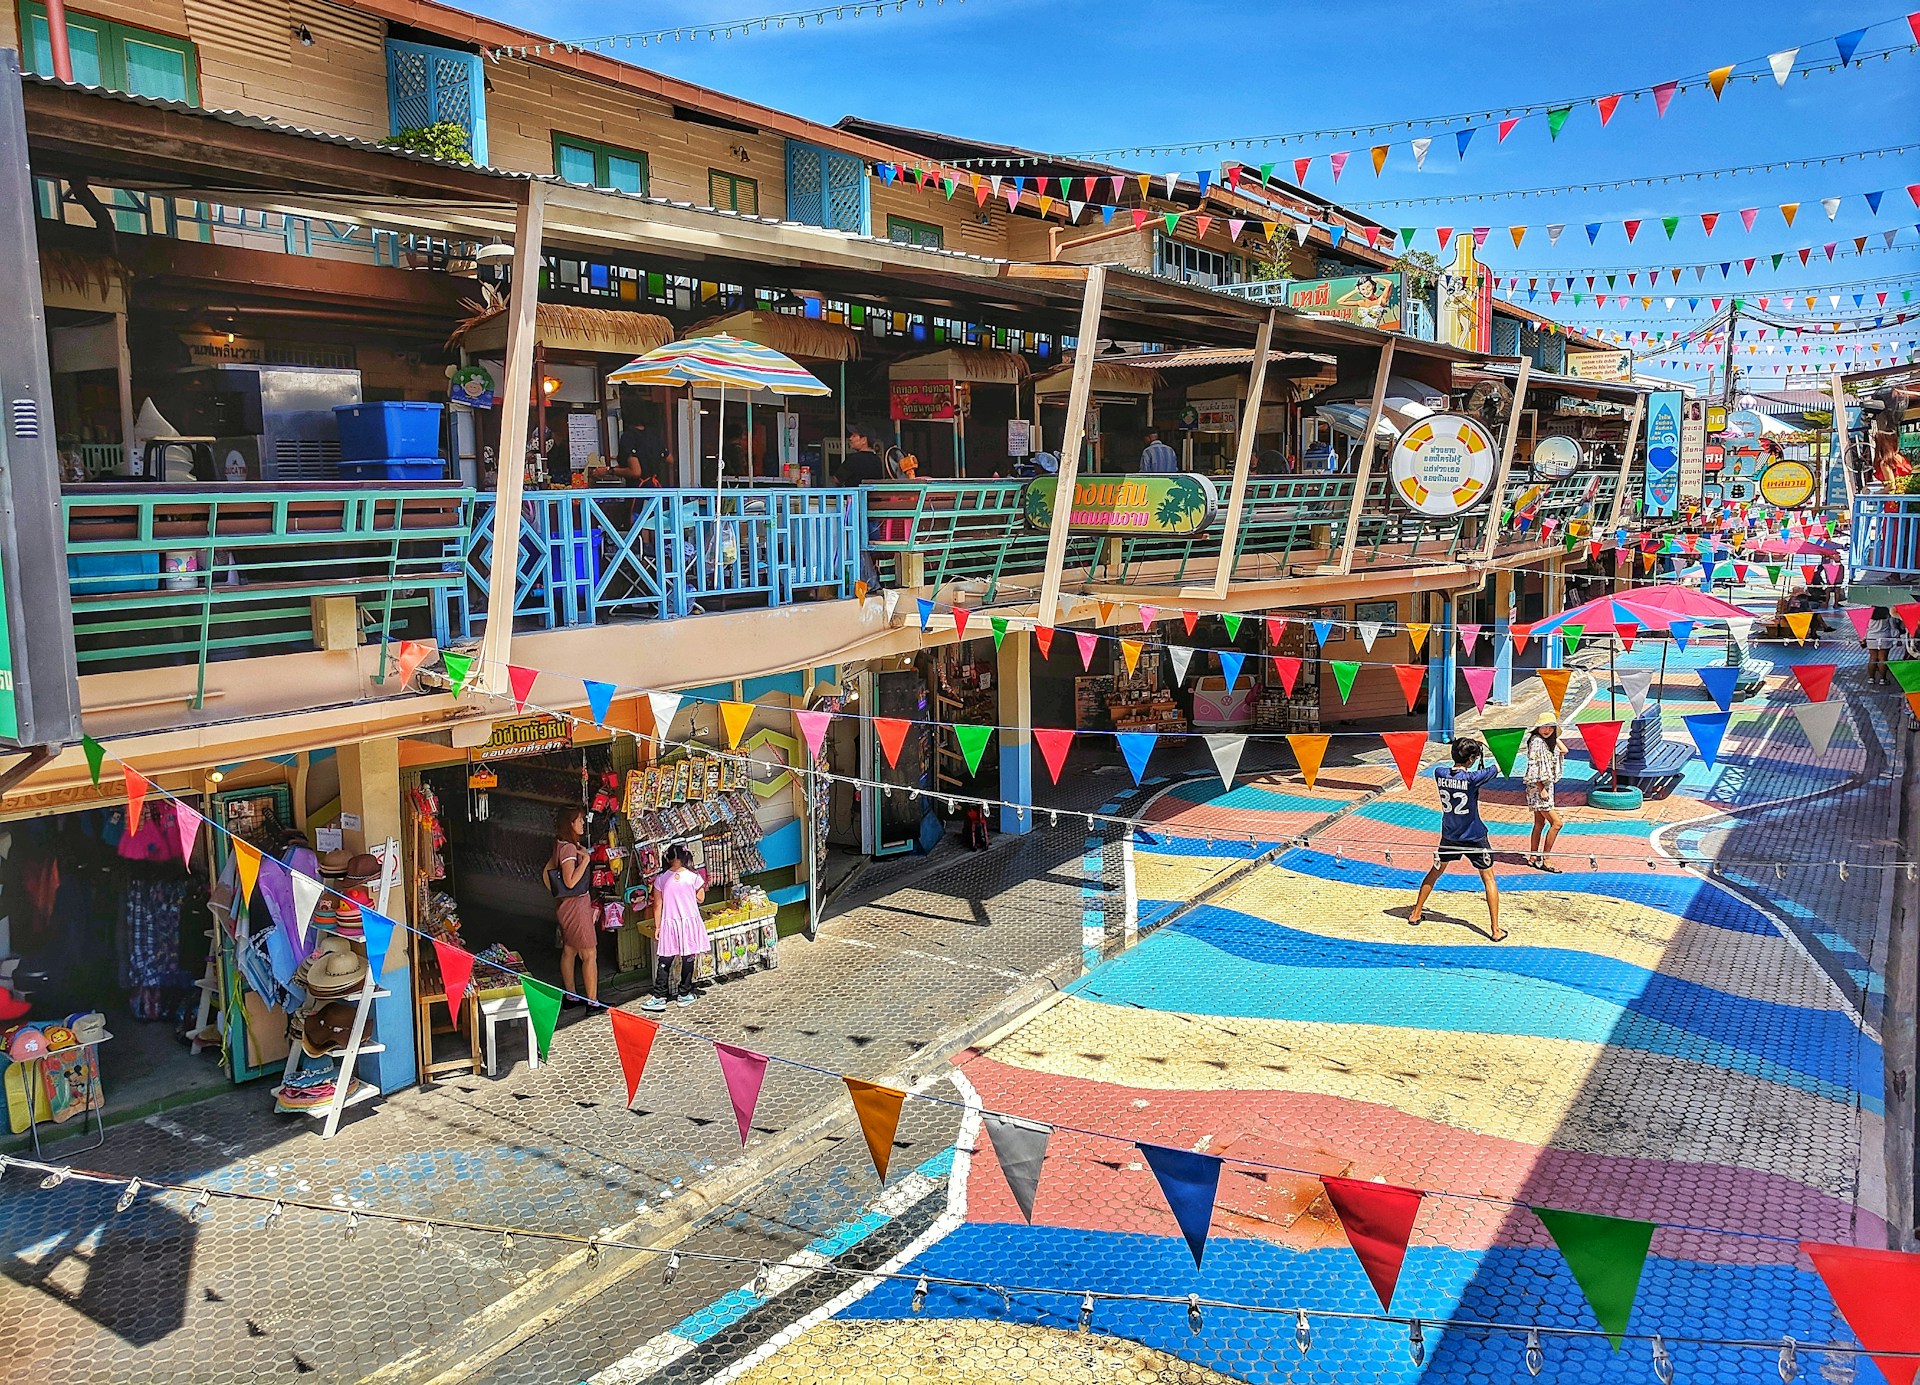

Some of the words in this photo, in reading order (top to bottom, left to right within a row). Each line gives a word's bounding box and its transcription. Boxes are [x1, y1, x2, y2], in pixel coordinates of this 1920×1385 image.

[1292, 282, 1329, 307] เทพี
[190, 342, 260, 361] าแฟเพลินวาน
[1074, 481, 1149, 507] างแสน
[486, 719, 567, 747] งฝากหัวหิน
[1440, 789, 1470, 815] 32
